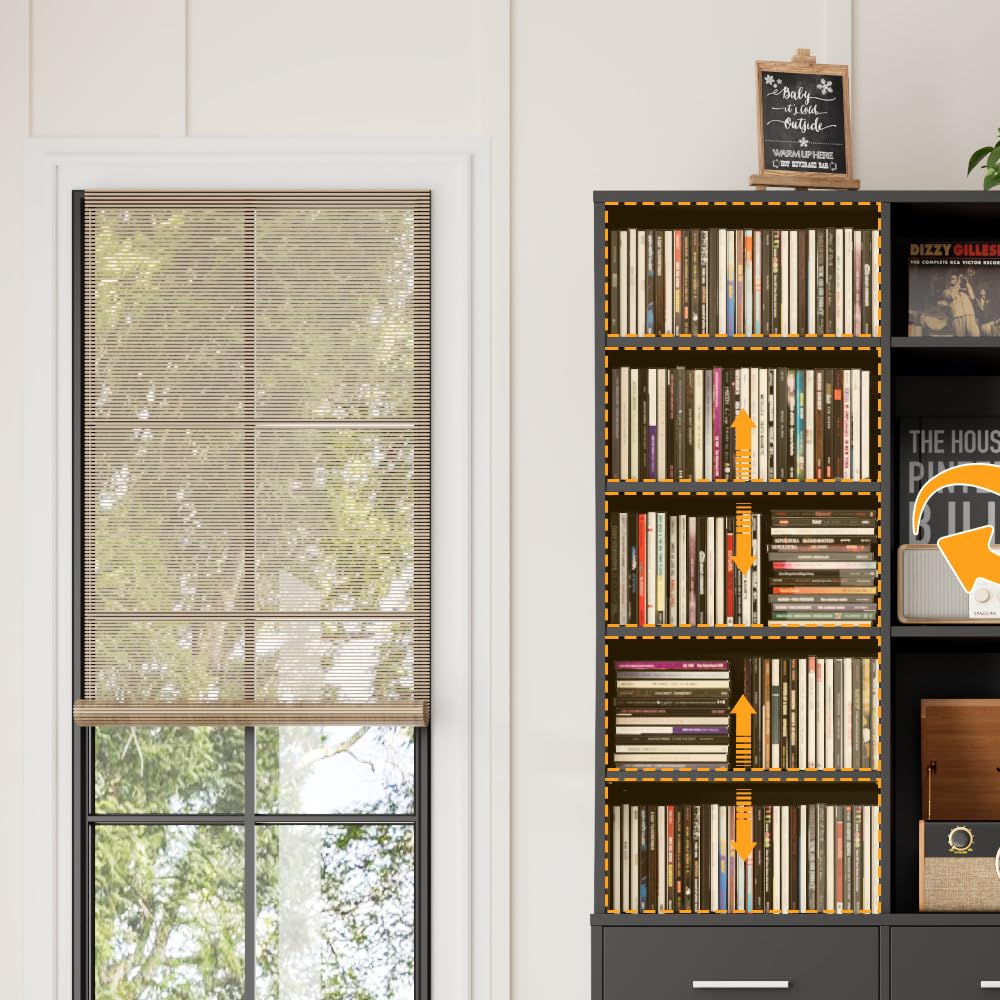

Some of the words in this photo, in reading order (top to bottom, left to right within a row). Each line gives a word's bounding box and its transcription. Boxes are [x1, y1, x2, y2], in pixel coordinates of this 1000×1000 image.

[772, 149, 800, 157] WARM
[801, 150, 811, 158] UP
[812, 151, 834, 159] HERE
[910, 243, 952, 256] DIZZY
[909, 429, 945, 454] THE
